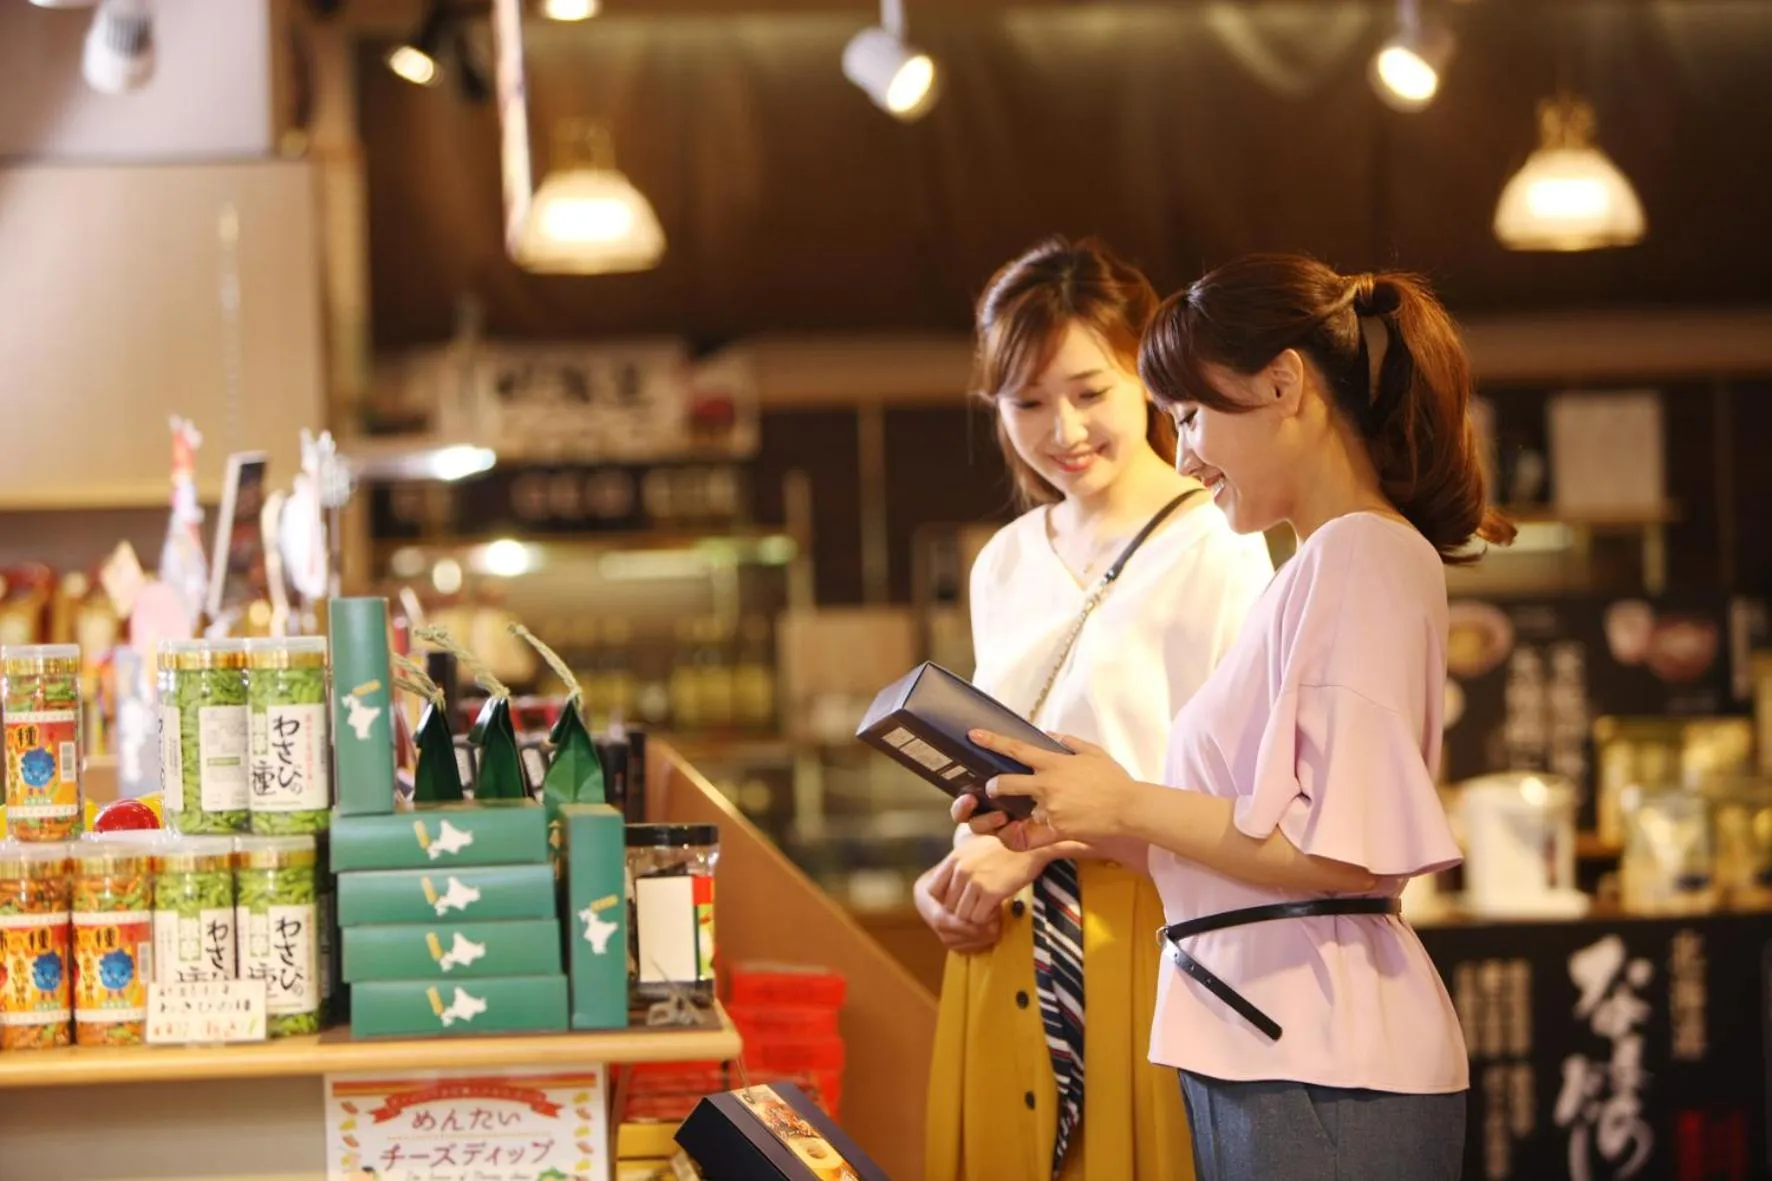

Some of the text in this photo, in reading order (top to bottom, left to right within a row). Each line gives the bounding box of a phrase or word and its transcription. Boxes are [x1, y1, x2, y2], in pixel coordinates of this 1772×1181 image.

[411, 1107, 521, 1132] めんたい
[379, 1139, 555, 1171] チーズディップ
